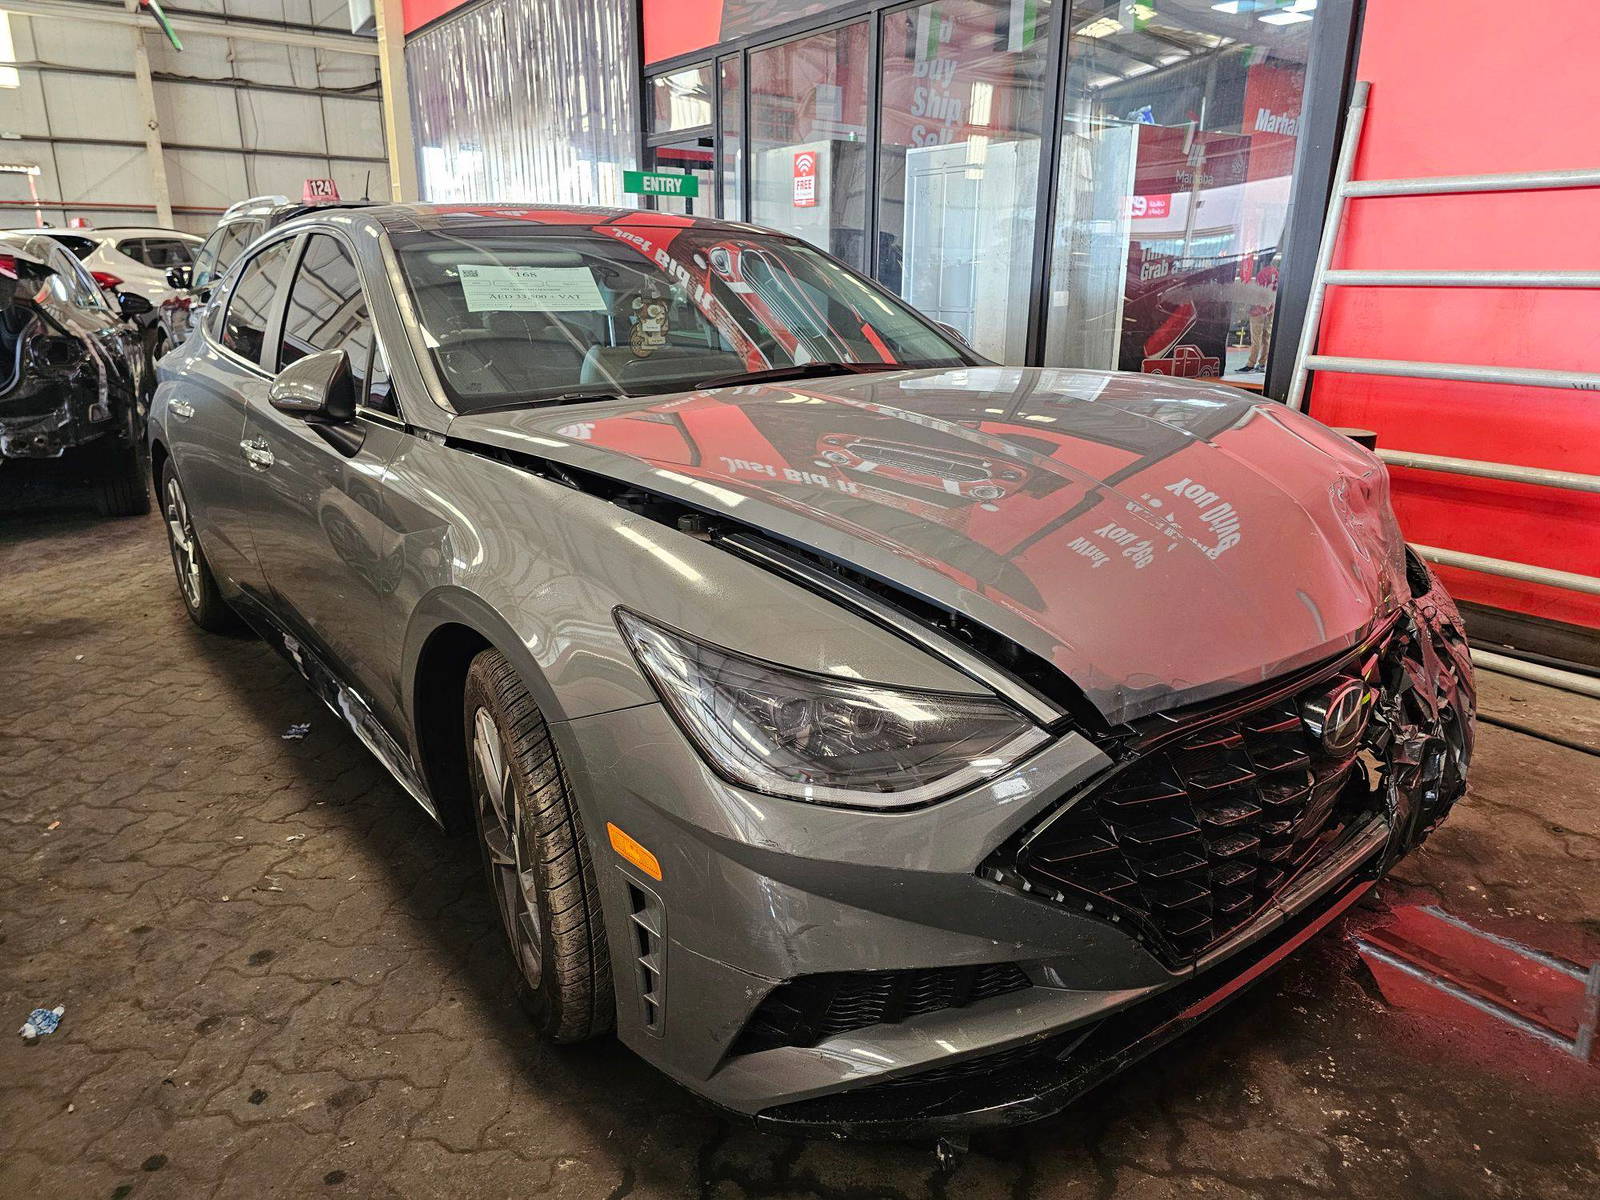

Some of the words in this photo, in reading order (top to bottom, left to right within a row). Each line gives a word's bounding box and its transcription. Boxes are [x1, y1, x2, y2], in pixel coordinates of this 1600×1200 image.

[911, 85, 961, 127] Ship
[1255, 108, 1299, 136] Marha
[643, 176, 682, 193] ENTRY
[1175, 170, 1214, 185] Maraba
[311, 180, 332, 196] 124
[1140, 260, 1168, 280] Grab
